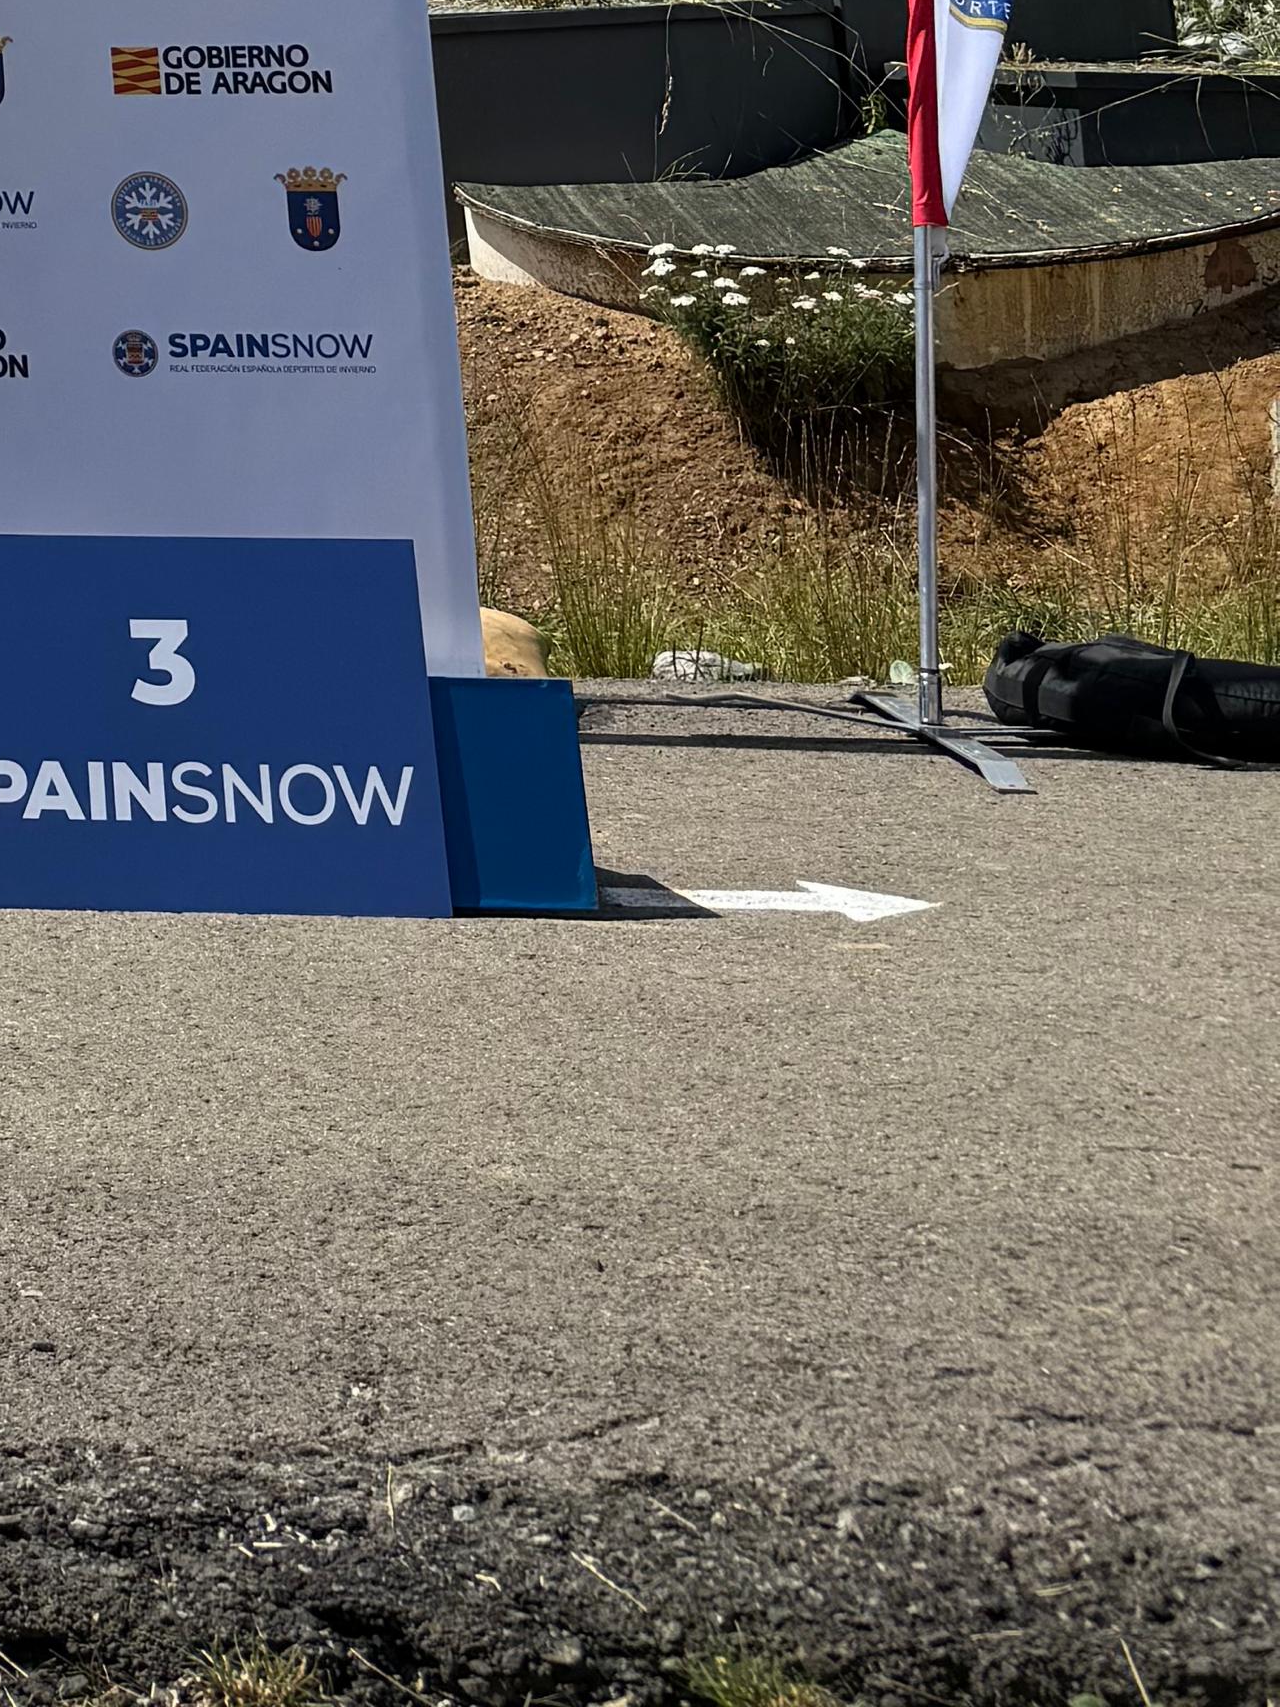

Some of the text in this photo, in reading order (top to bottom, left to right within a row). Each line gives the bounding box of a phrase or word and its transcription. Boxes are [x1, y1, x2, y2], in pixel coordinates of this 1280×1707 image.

[162, 44, 309, 69] GOBIERNO
[164, 70, 333, 95] DE ARAGON
[168, 333, 373, 359] SPAINSNOW
[129, 618, 197, 706] 3
